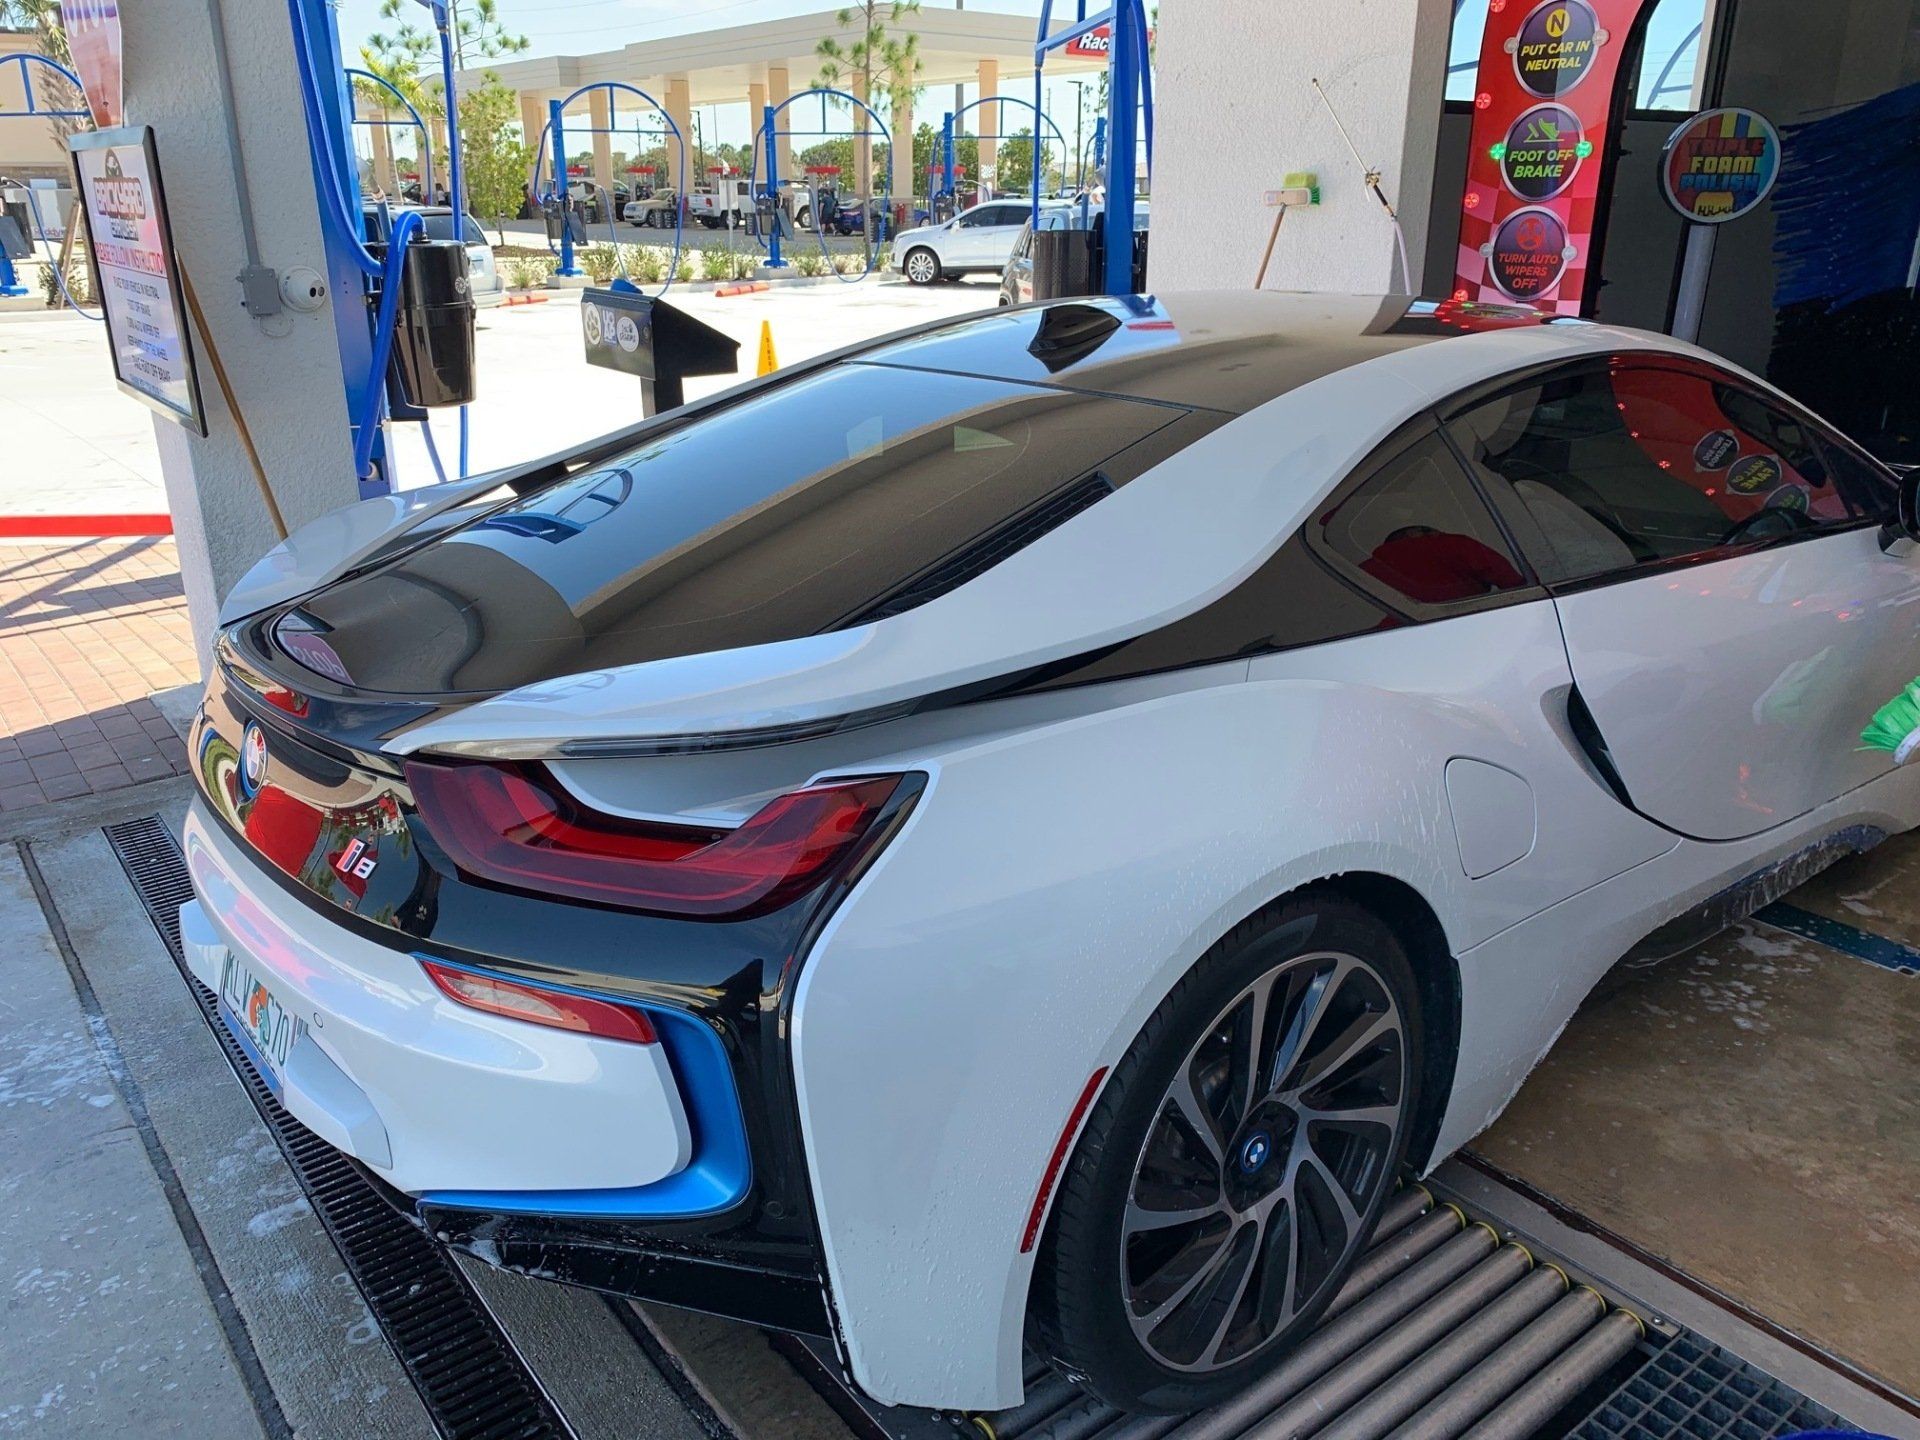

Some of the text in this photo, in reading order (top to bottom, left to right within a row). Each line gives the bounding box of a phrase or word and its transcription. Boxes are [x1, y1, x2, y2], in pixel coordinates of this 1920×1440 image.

[1078, 32, 1109, 51] Rac
[1521, 40, 1592, 56] PUT CAR IN
[1525, 57, 1582, 71] NEUTRAL
[1688, 137, 1765, 156] TRIPLE
[1509, 149, 1574, 162] FOOT OFF
[1513, 164, 1564, 178] BRAKE
[1690, 156, 1756, 173] FOAM
[1680, 173, 1760, 190] POLISH
[1499, 252, 1559, 265] TURN AUTO
[1505, 266, 1548, 277] WIPERS
[1512, 278, 1538, 289] OFF
[336, 838, 377, 879] i8
[225, 954, 252, 1013] KLV
